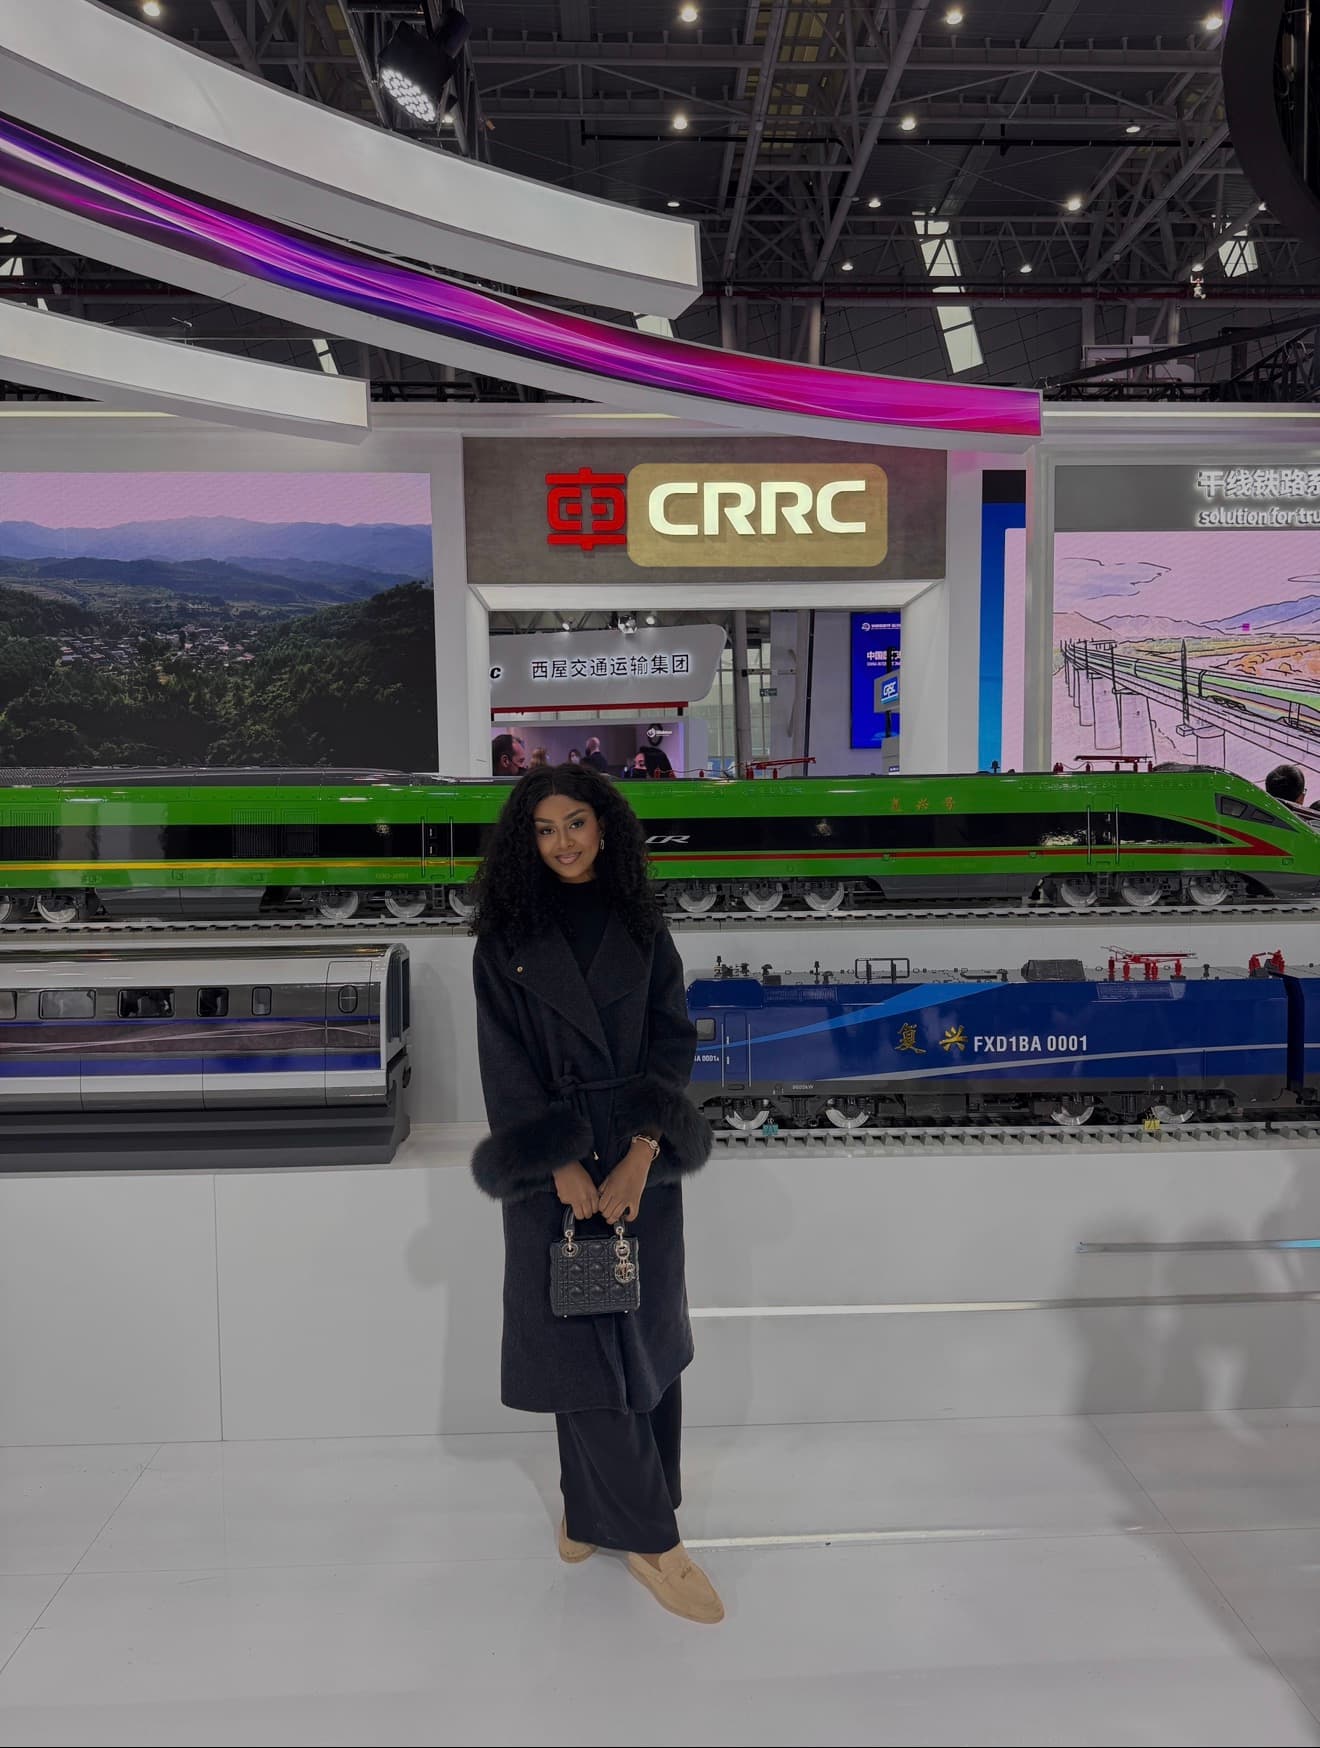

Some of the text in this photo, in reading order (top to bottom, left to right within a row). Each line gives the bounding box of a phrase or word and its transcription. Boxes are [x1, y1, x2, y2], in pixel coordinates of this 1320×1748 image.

[648, 479, 867, 536] CRRC
[1198, 507, 1268, 526] solution
[1270, 506, 1296, 526] for
[531, 654, 689, 680] 西屋交通运输集团
[973, 1035, 1088, 1052] FXD1BA 0001
